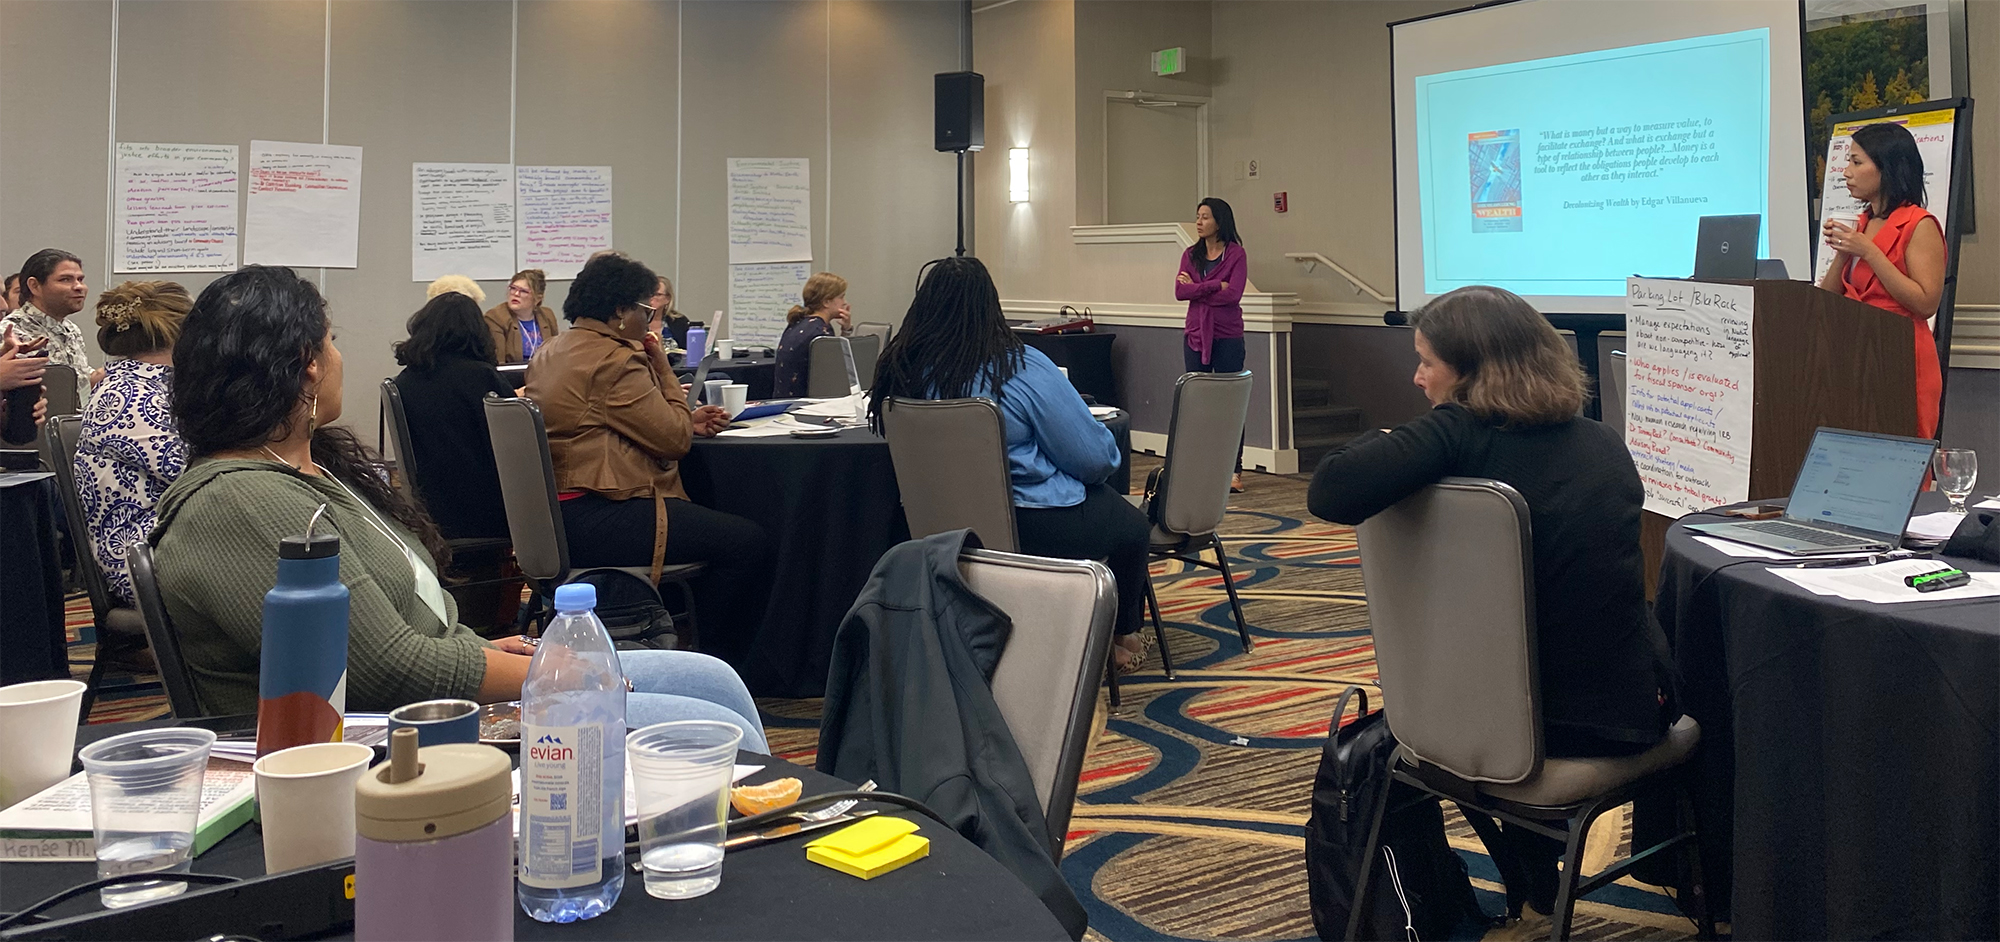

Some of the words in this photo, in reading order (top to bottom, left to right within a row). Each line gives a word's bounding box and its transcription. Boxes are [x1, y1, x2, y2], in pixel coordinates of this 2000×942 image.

[1564, 130, 1570, 139] is
[1571, 130, 1594, 139] money
[1596, 126, 1608, 136] but
[1617, 126, 1631, 136] way
[1634, 124, 1641, 132] to
[1643, 122, 1675, 131] measure
[1676, 118, 1702, 128] value,
[1704, 117, 1713, 126] to
[1536, 142, 1568, 155] facilitate
[1569, 138, 1606, 150] exchange?
[1608, 136, 1624, 146] And
[1625, 135, 1645, 144] what
[1646, 133, 1653, 142] is
[1655, 131, 1691, 143] exchange
[1693, 129, 1706, 139] but
[1708, 130, 1715, 138] a
[1537, 155, 1551, 165] type
[1553, 152, 1561, 164] of
[1561, 149, 1604, 163] relationship
[1605, 147, 1634, 157] between
[1700, 141, 1708, 150] is
[1534, 164, 1547, 173] tool
[1548, 164, 1556, 172] to
[1557, 161, 1578, 175] reflect
[1579, 161, 1591, 171] the
[1592, 158, 1631, 172] obligations
[1633, 157, 1657, 171] people
[1659, 155, 1689, 167] develop
[1690, 154, 1699, 163] to
[1700, 152, 1719, 162] each
[1581, 172, 1600, 181] other
[1601, 172, 1609, 180] as
[1611, 170, 1626, 182] they
[1563, 200, 1604, 210] Decolonizing
[1606, 198, 1629, 207] Wealth
[1631, 197, 1640, 209] by
[1642, 197, 1664, 208] Edgar
[1666, 195, 1708, 204] Villanueva
[1632, 284, 1664, 306] Parking
[1668, 289, 1683, 303] Lot
[1714, 294, 1737, 311] Rack
[1635, 316, 1661, 331] Manage
[1663, 320, 1711, 336] expectations
[1636, 331, 1653, 340] about
[1634, 358, 1649, 370] Who
[1651, 364, 1679, 377] applies
[1697, 372, 1739, 391] evaluated
[1634, 369, 1645, 381] for
[1647, 373, 1665, 387] fiscal
[1668, 379, 1696, 393] sponsor
[1702, 441, 1735, 465] Community
[1641, 461, 1674, 477] coordination
[1673, 482, 1682, 492] for
[1684, 486, 1700, 498] tribal
[530, 745, 573, 761] evian
[534, 761, 547, 769] Live
[3, 836, 59, 859] Renée
[67, 839, 91, 858] M.
